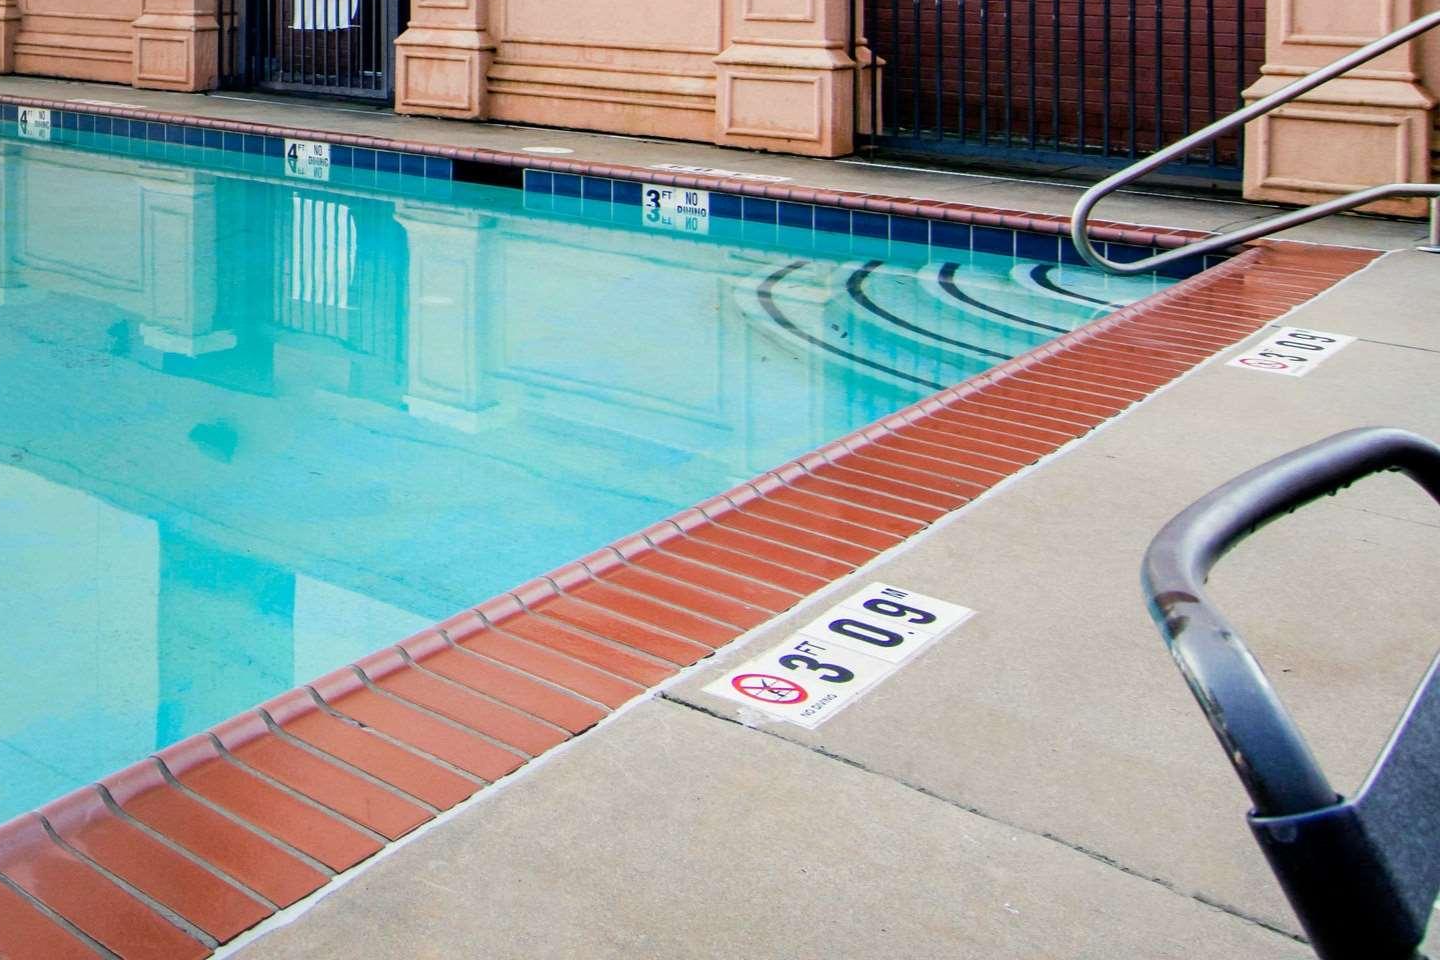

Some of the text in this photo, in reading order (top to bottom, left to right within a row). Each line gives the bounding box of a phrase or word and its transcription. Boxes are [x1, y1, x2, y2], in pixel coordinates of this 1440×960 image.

[20, 110, 28, 123] 4
[288, 143, 298, 159] 4
[646, 189, 673, 209] 3 FT
[685, 191, 698, 206] NO
[794, 640, 827, 659] FT
[778, 653, 855, 684] 3
